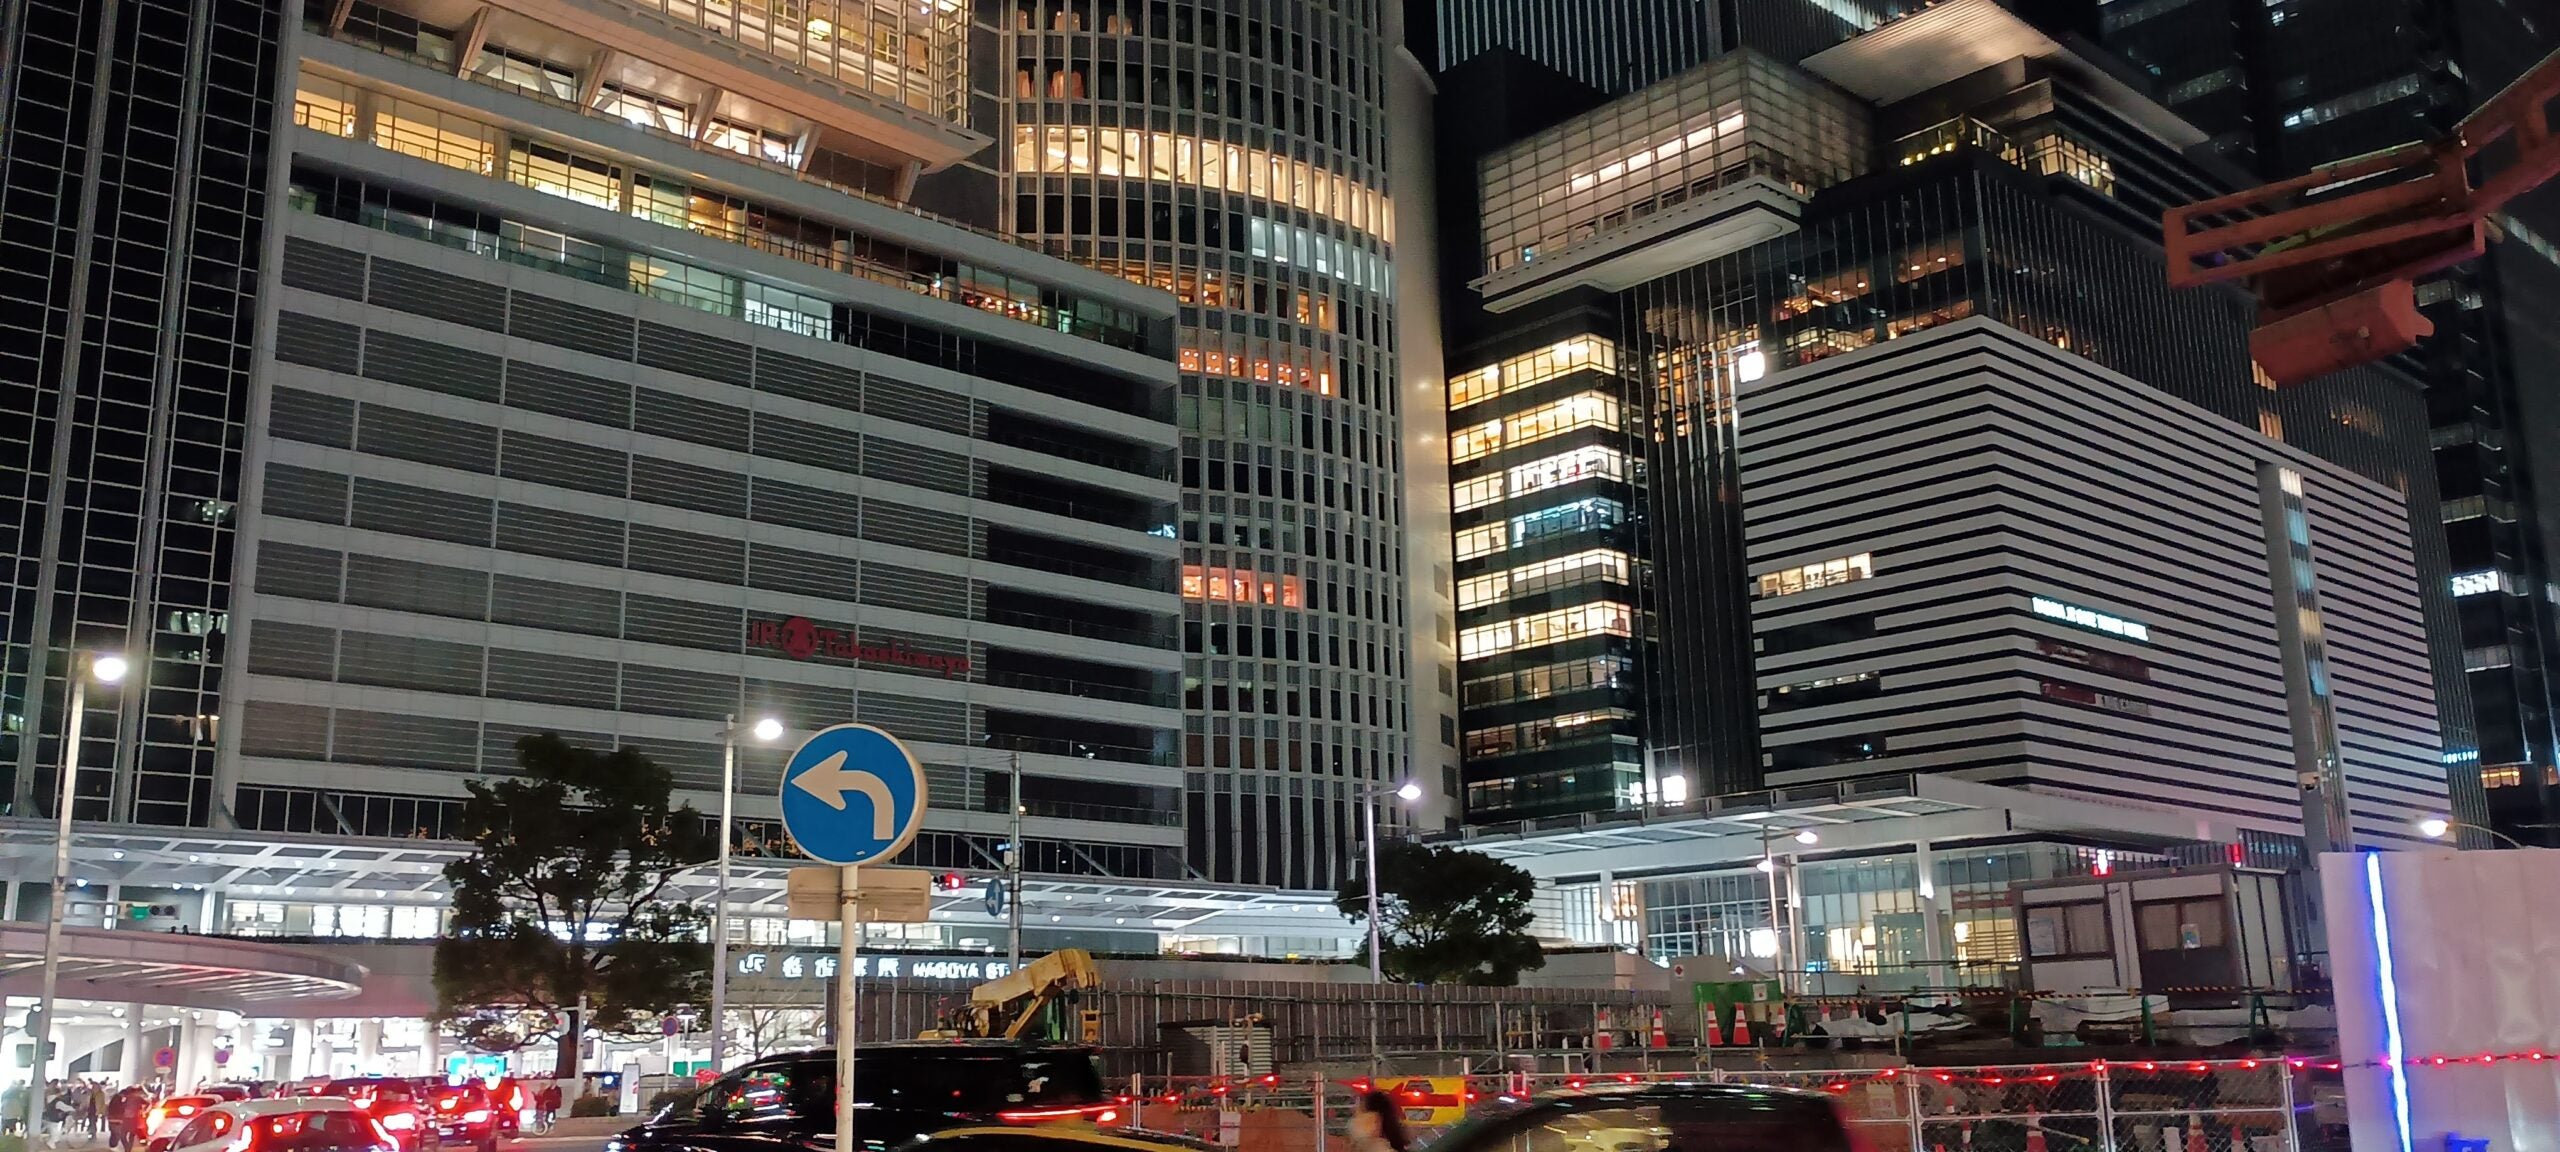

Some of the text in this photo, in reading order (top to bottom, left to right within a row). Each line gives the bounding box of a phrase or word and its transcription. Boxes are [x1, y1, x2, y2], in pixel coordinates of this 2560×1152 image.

[747, 620, 971, 679] JR Takashimaya
[912, 961, 979, 979] NAGOYA
